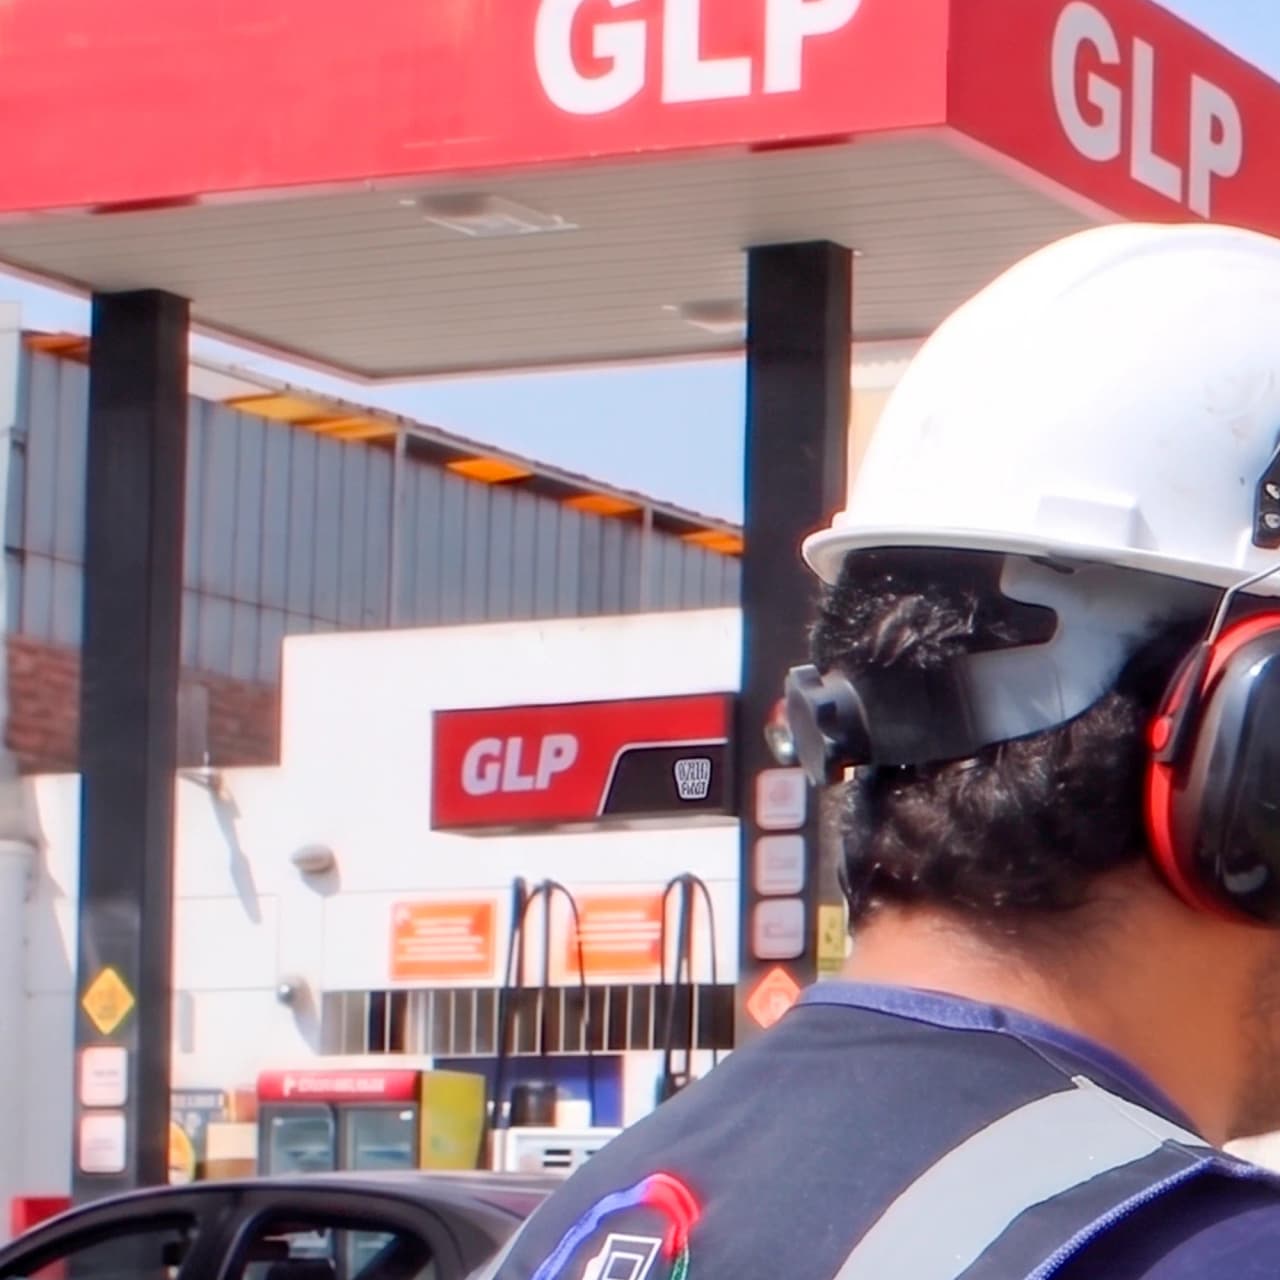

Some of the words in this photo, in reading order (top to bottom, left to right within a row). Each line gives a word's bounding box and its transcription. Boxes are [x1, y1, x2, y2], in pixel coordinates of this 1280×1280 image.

[533, 0, 861, 115] GLP
[1050, 0, 1243, 219] GLP
[461, 733, 579, 796] GLP
